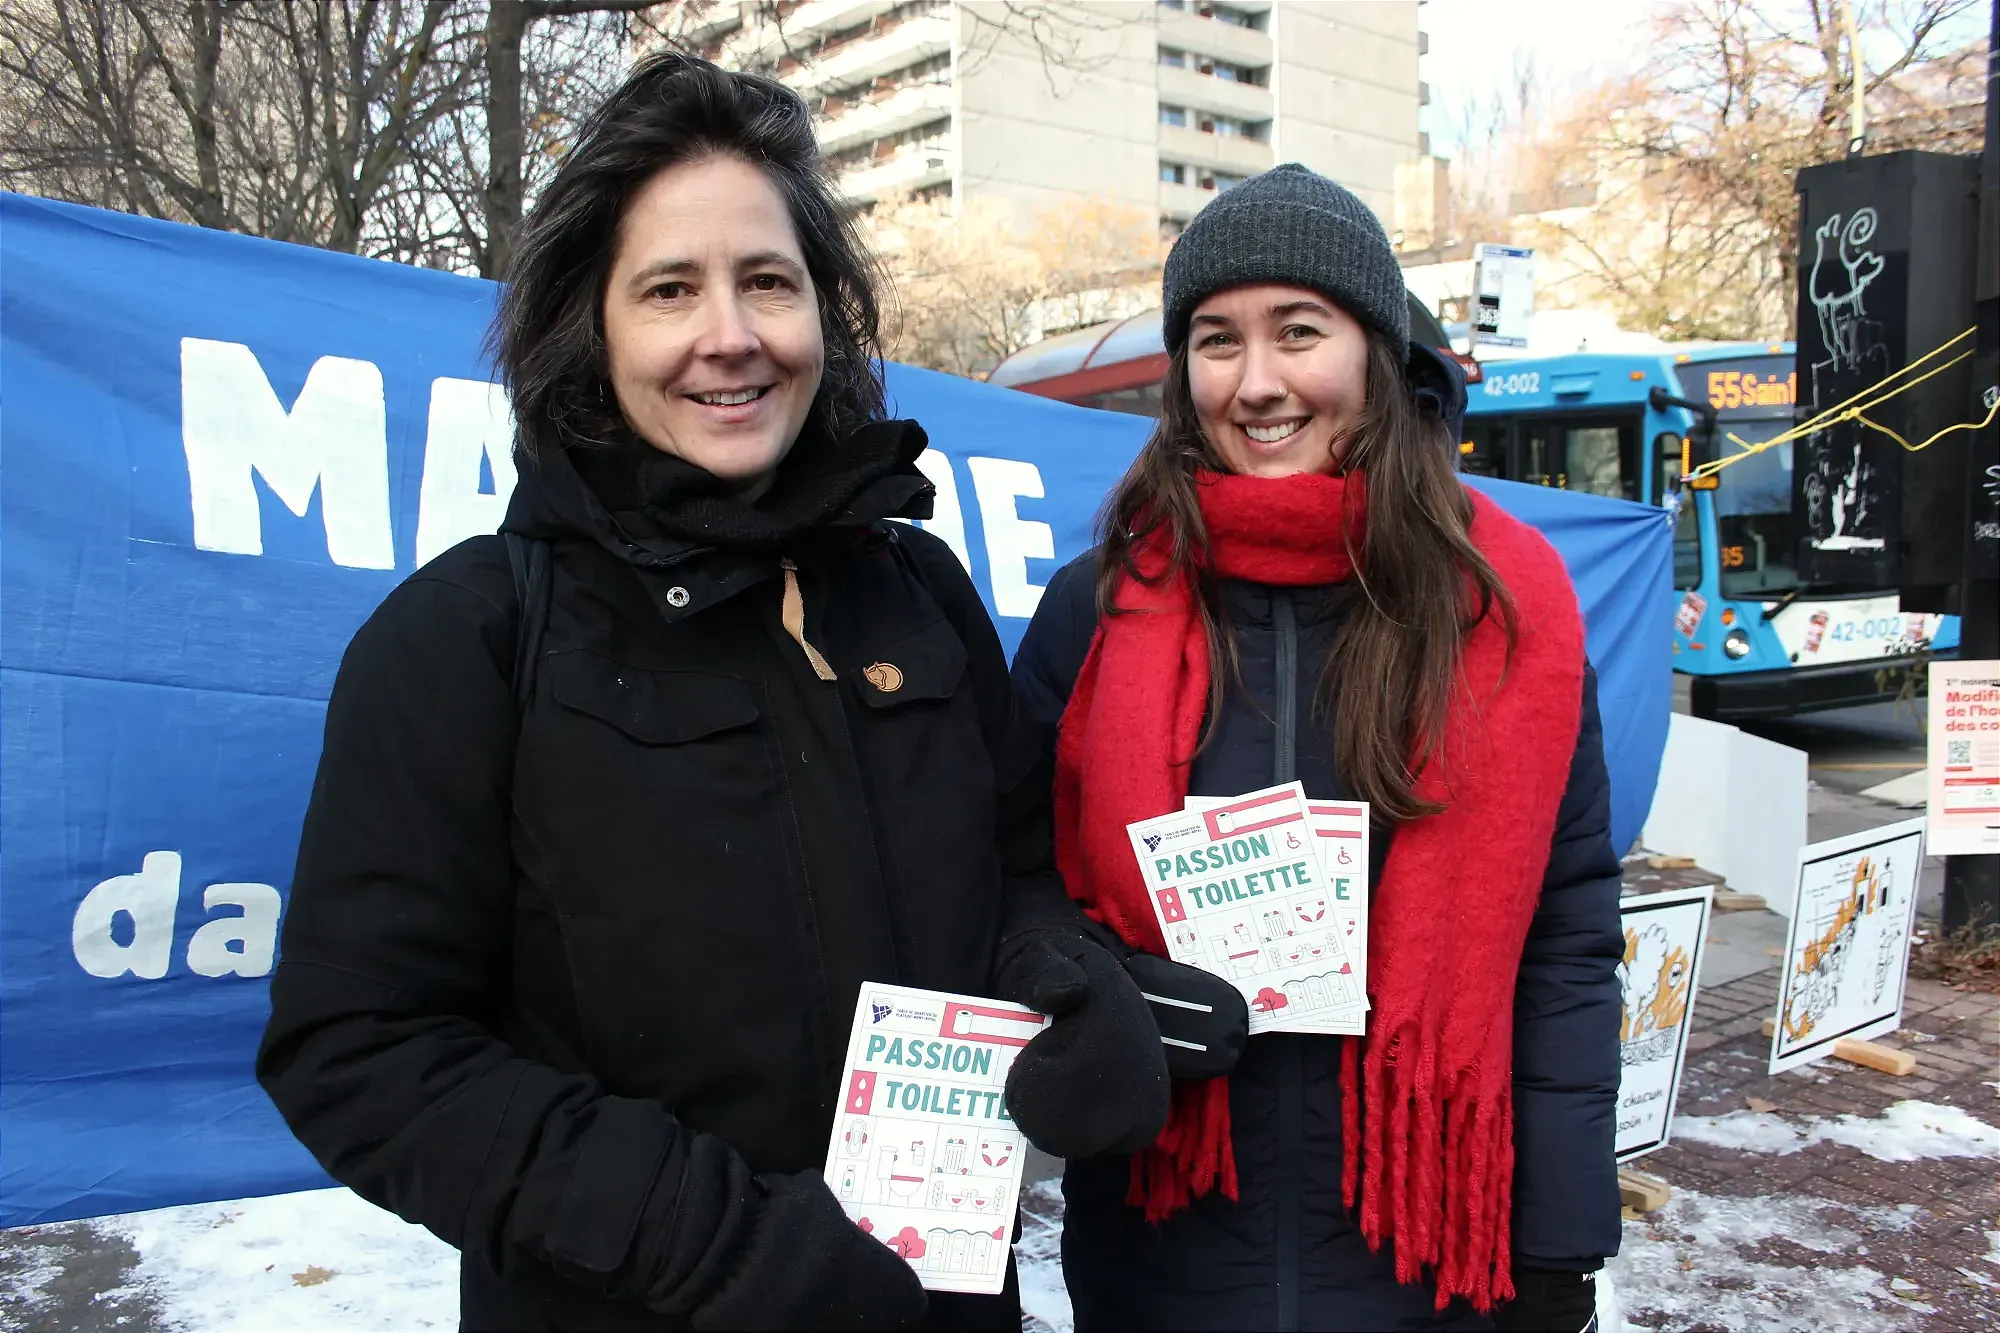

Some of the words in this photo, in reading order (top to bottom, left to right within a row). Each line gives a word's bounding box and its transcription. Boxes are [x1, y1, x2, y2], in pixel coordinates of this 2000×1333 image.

[1484, 372, 1541, 396] 42-002
[1831, 616, 1900, 641] 42-002
[1946, 706, 1966, 717] de
[1946, 720, 1976, 731] des
[1155, 833, 1271, 882] PASSION
[1188, 862, 1312, 909] TOILETTE
[1332, 878, 1350, 901] E
[865, 1034, 993, 1075] PASSION
